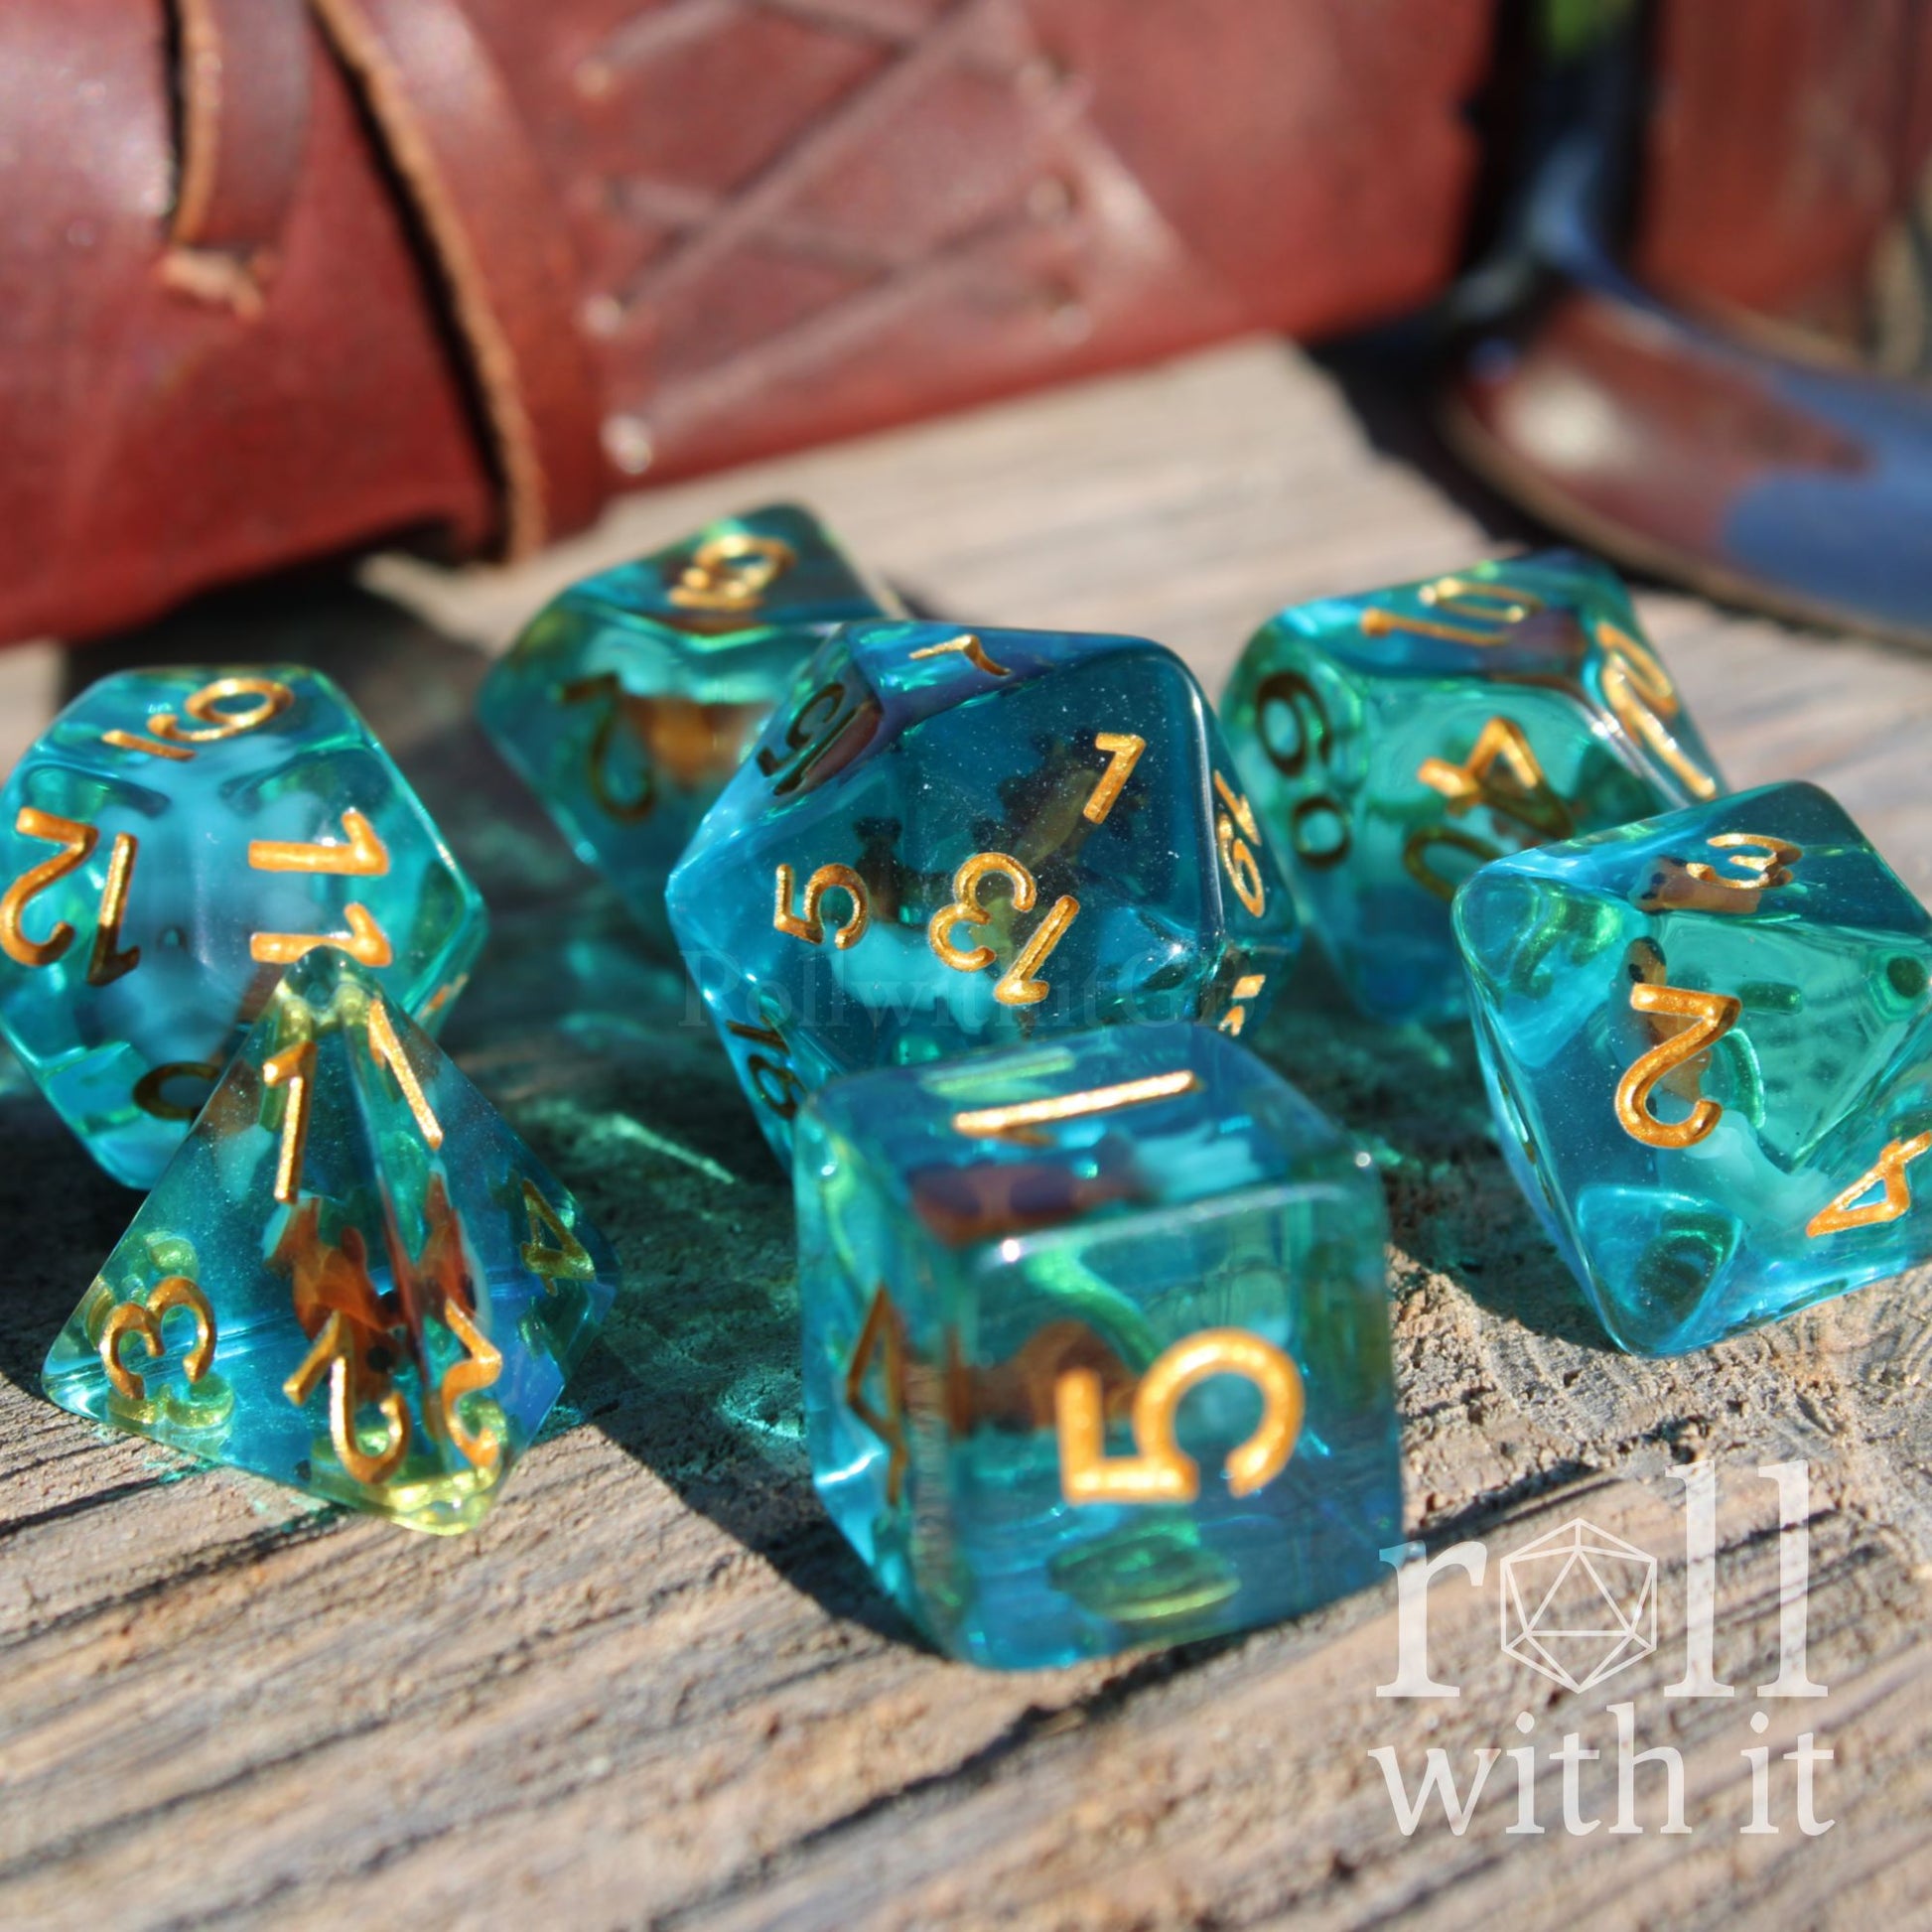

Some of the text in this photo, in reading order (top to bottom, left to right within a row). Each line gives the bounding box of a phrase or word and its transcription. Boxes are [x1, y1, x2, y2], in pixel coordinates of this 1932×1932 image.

[0, 806, 140, 987] 12
[247, 807, 393, 968] 11
[773, 862, 870, 951] 5
[928, 852, 1081, 1007] 13
[262, 1038, 319, 1204] 1
[1614, 982, 1742, 1150] 2
[1805, 1130, 1932, 1239] 4
[99, 1274, 218, 1401] 3
[1052, 1325, 1308, 1507] 5
